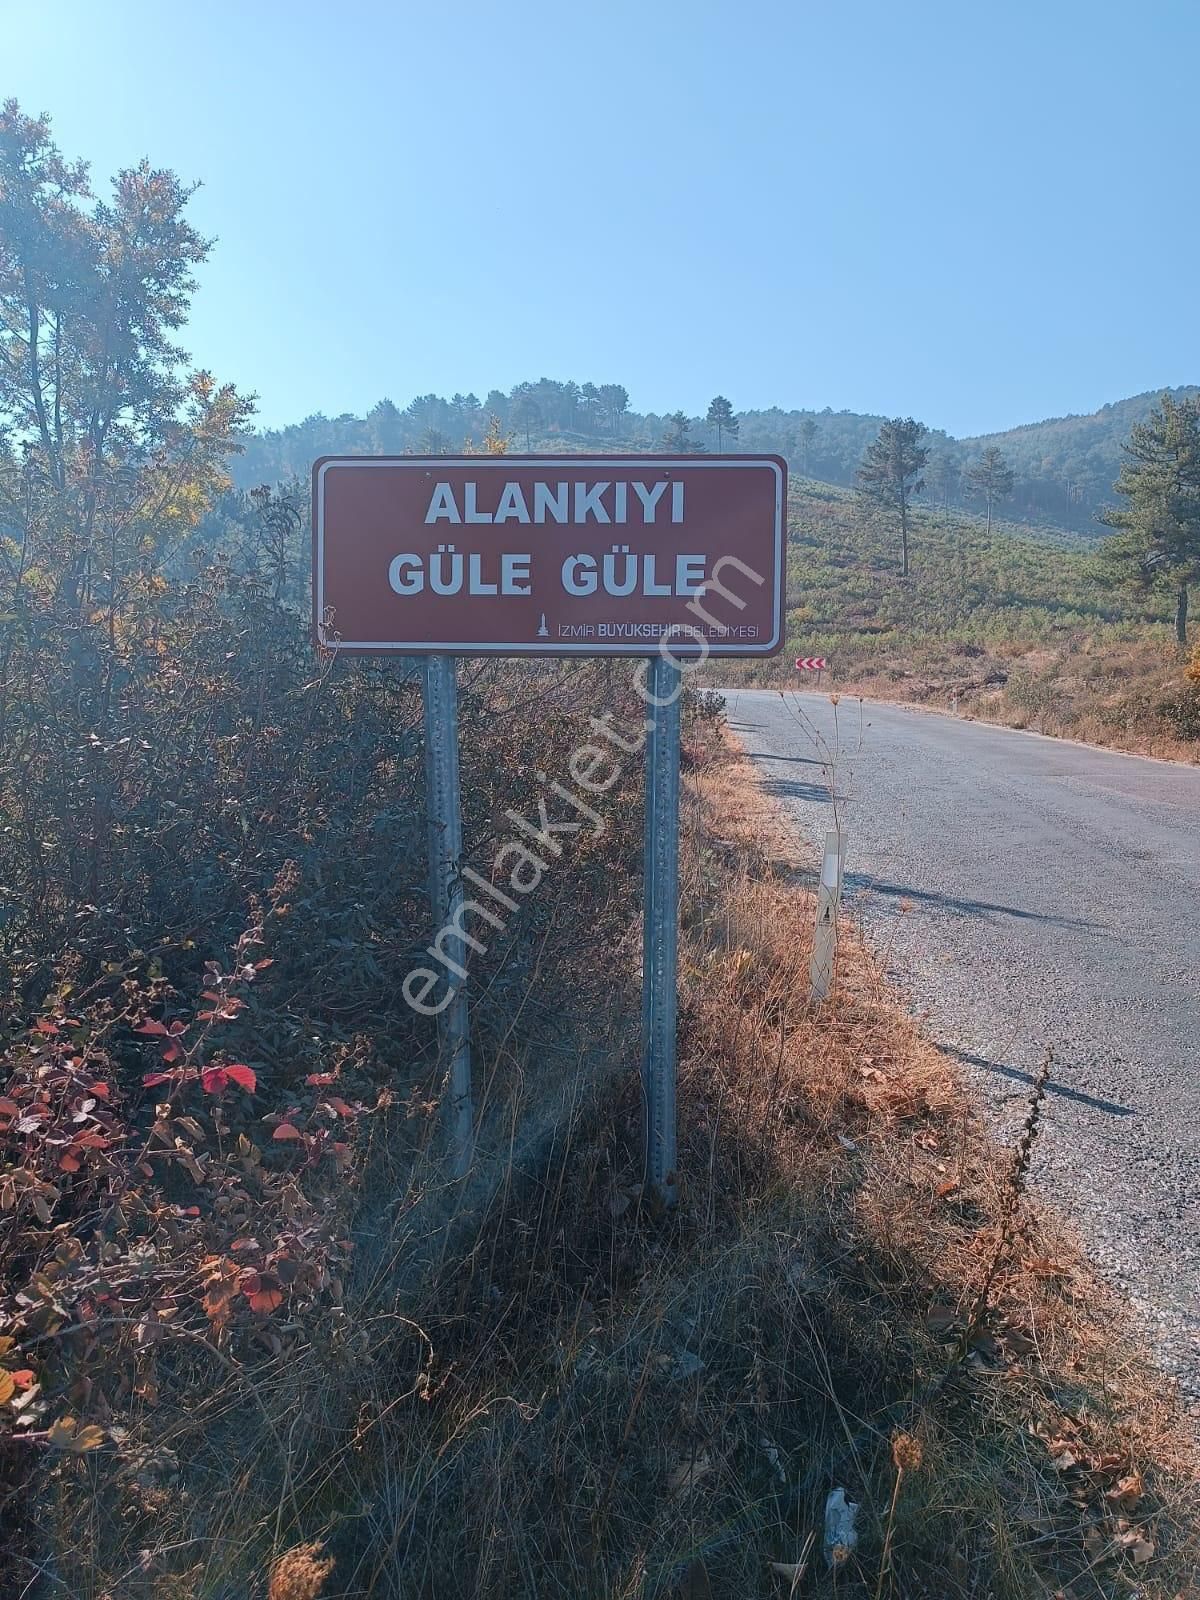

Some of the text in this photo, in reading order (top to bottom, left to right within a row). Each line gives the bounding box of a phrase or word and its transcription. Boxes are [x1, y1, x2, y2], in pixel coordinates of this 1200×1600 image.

[424, 481, 685, 524] ALANKIYI
[388, 544, 707, 596] GÜLE GÜLE
[557, 622, 595, 637] İZMİR
